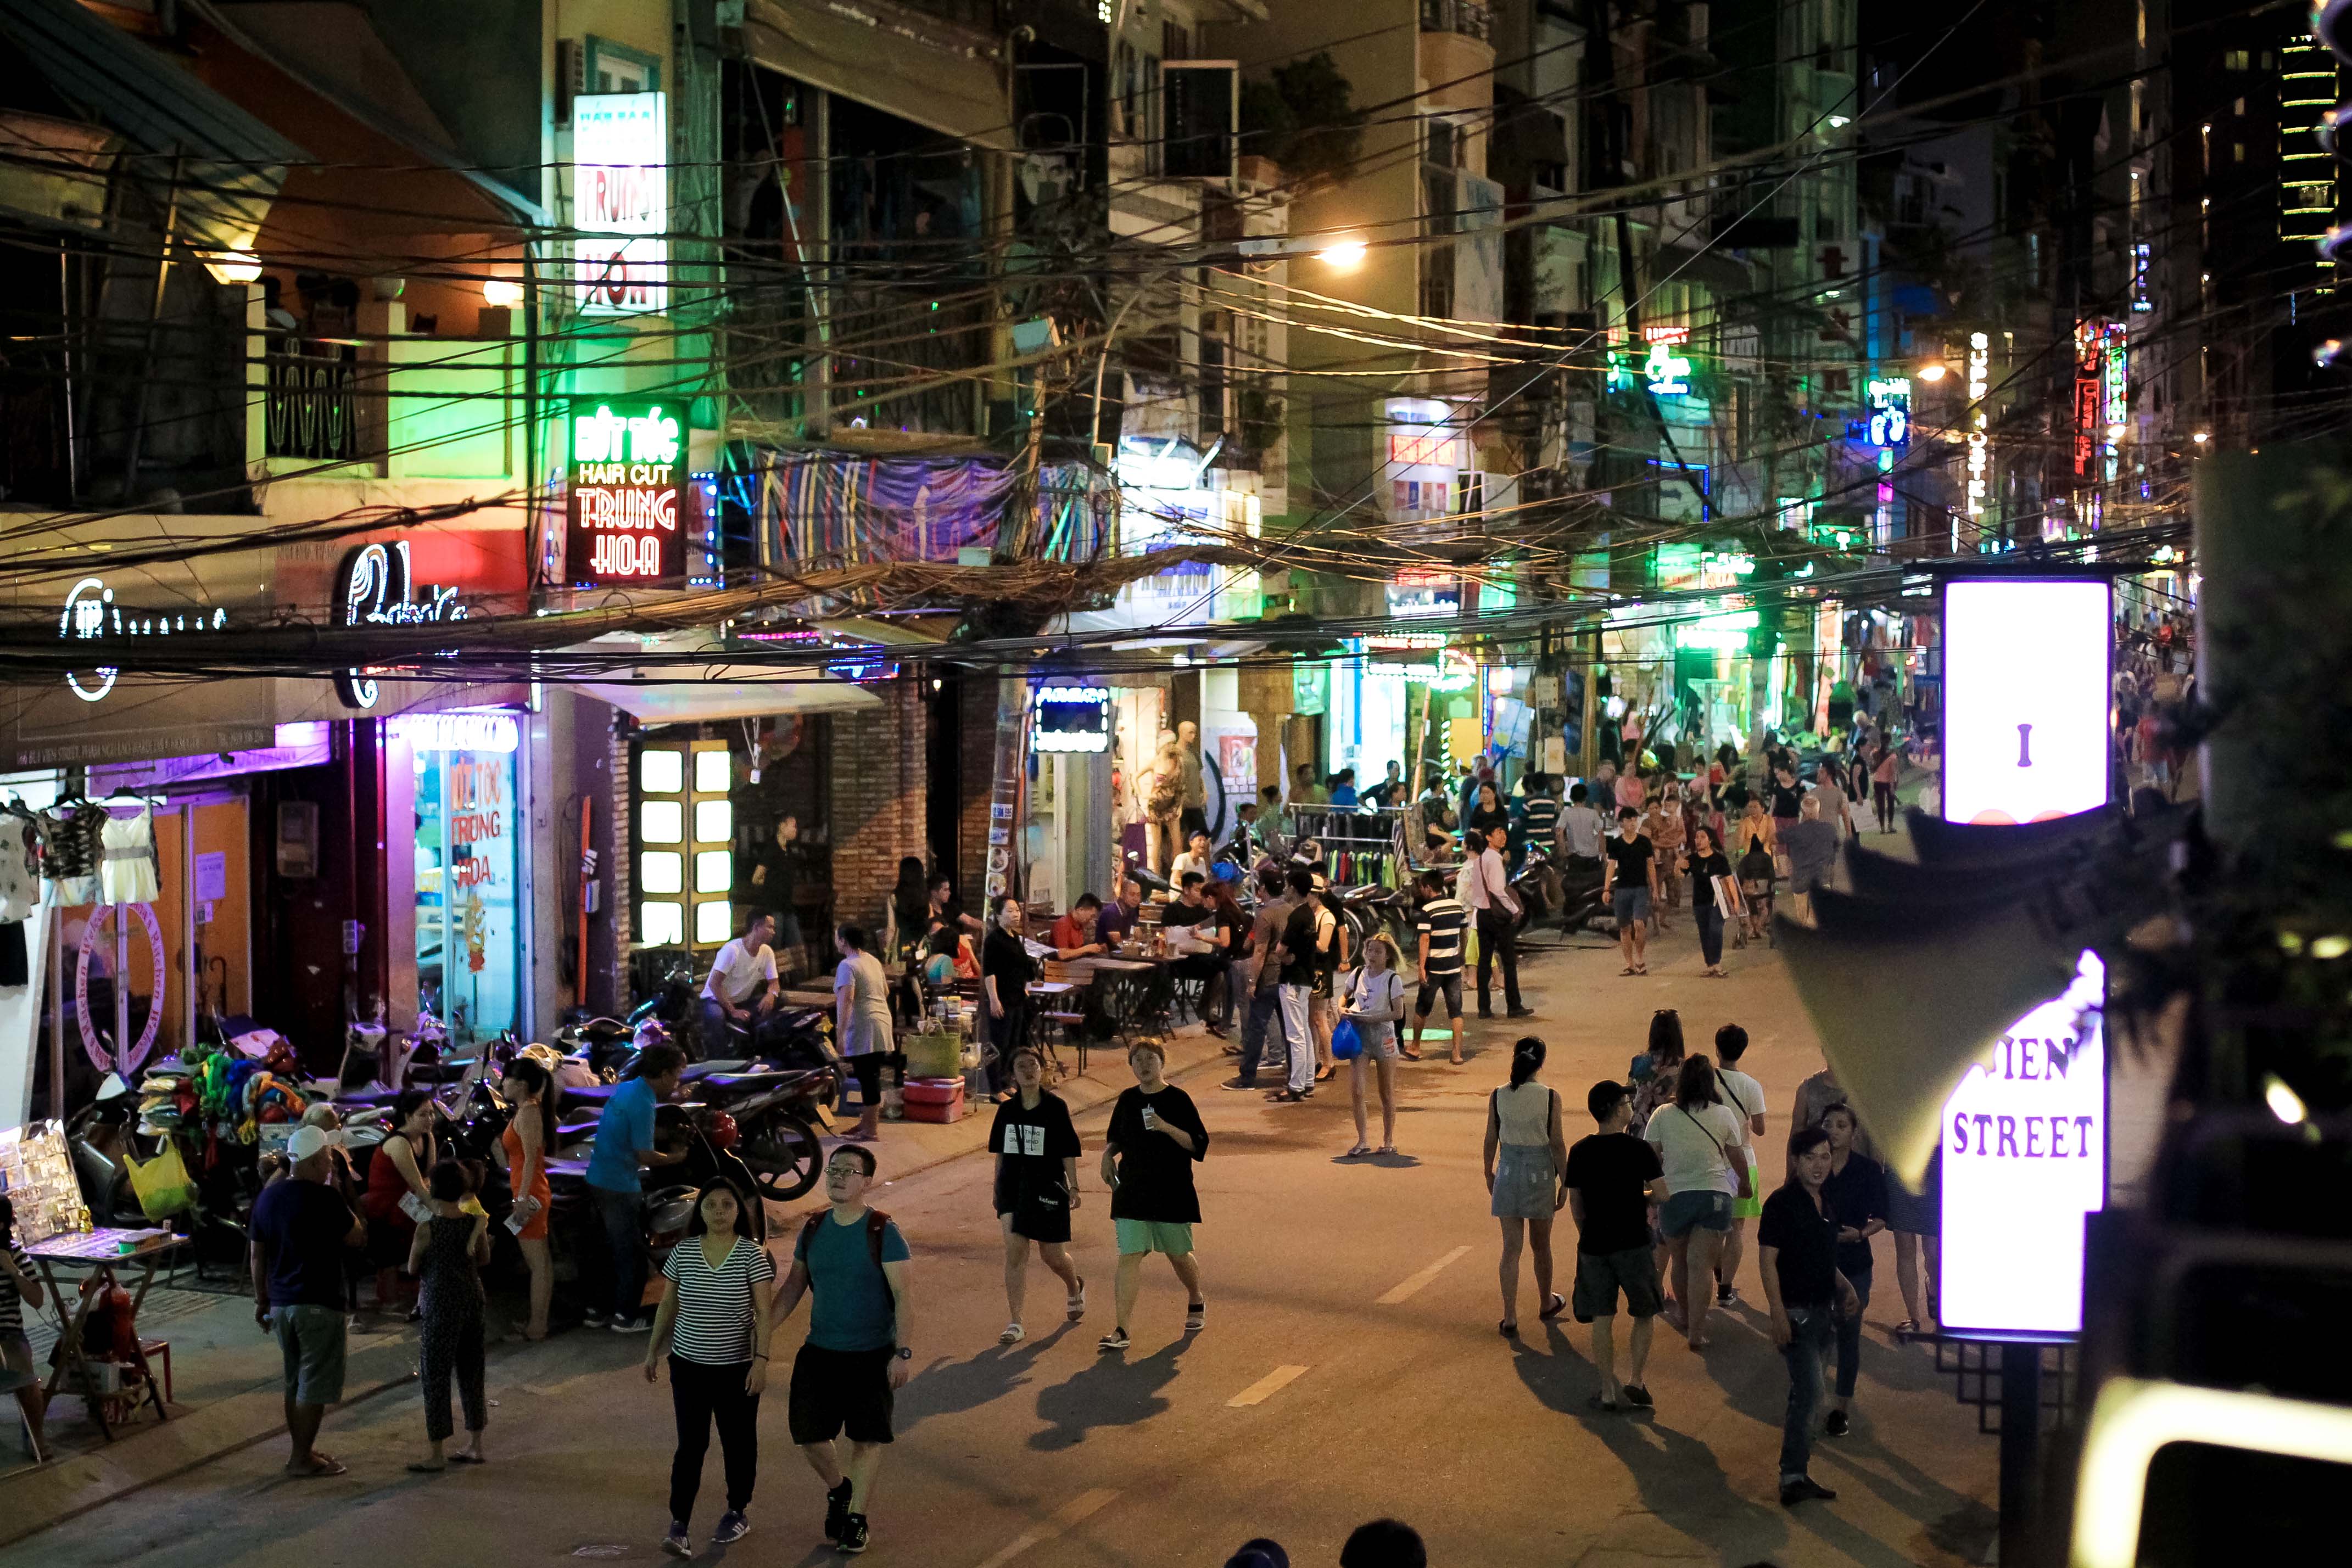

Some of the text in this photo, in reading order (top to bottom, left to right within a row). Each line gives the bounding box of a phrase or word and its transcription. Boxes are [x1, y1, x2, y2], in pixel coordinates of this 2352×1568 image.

[579, 462, 673, 486] HAIR CUT
[575, 487, 676, 530] TRUNG
[589, 534, 660, 576] HOA
[2017, 724, 2032, 767] I
[451, 811, 500, 846] TRUNG
[457, 855, 491, 888] HOA
[1953, 1112, 2093, 1158] STREET
